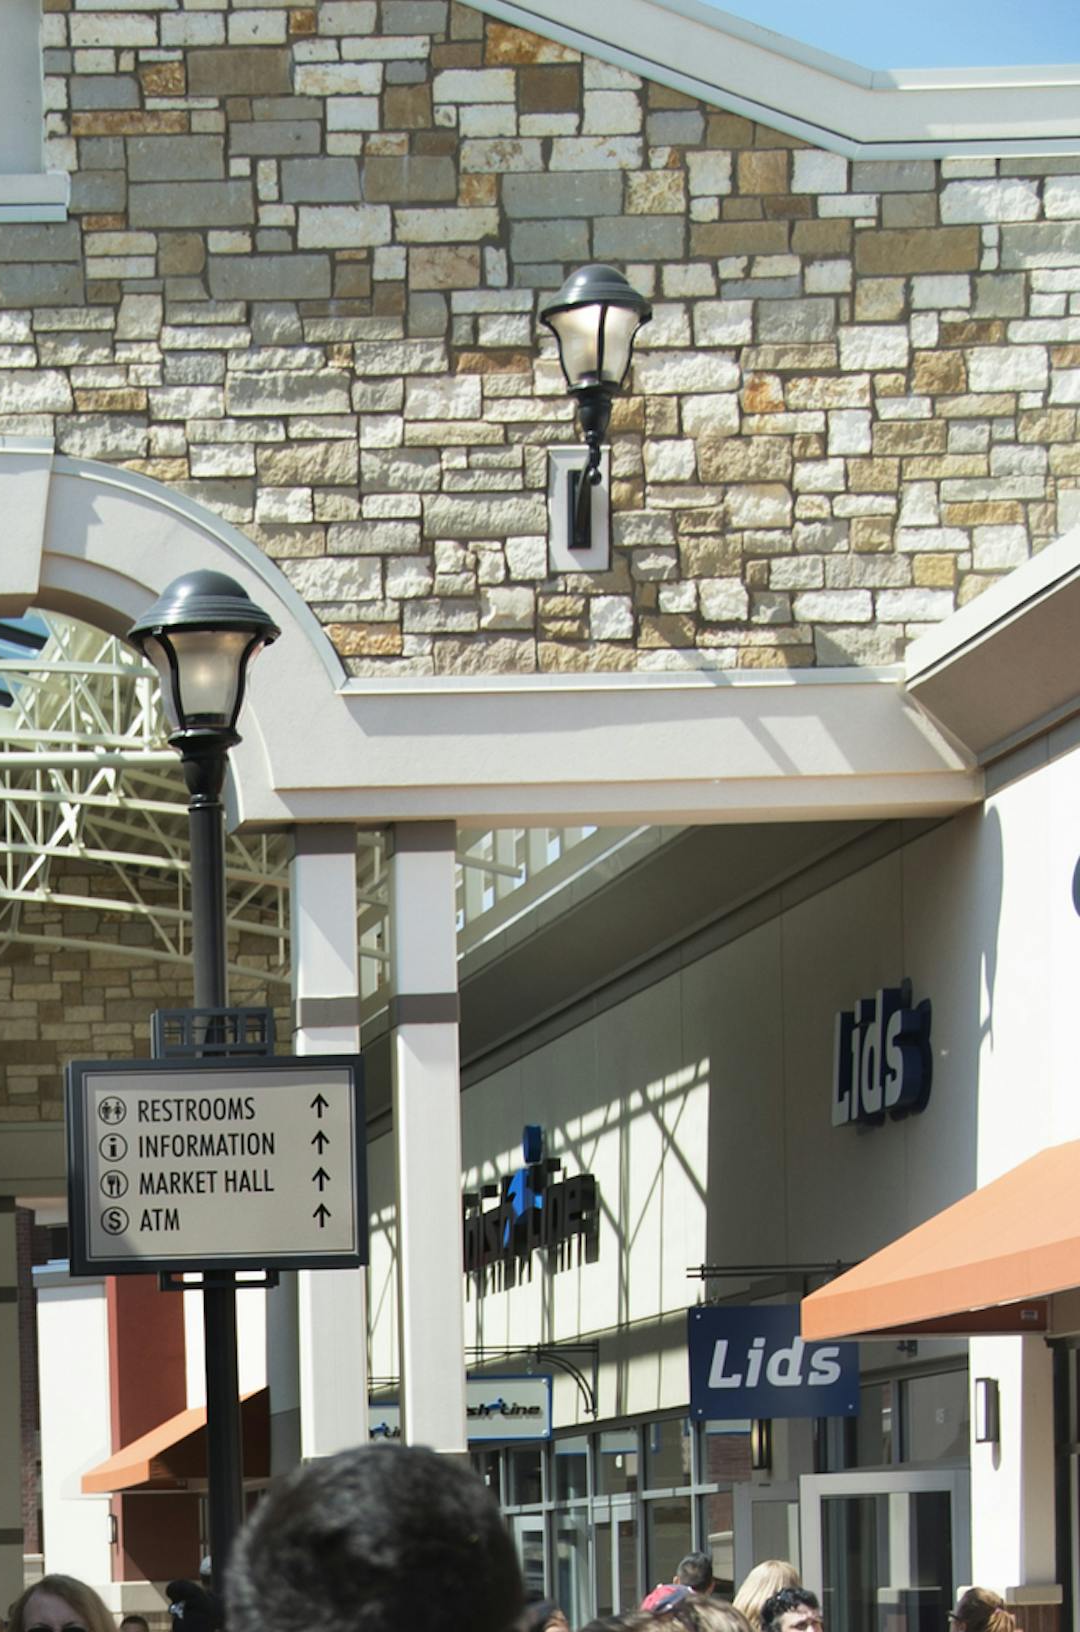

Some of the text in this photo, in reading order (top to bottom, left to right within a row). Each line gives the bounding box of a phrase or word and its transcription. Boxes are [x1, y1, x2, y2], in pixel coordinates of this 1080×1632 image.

[831, 984, 916, 1128] Lids
[138, 1097, 256, 1122] RESTROOMS
[139, 1132, 275, 1158] INFORMATION
[139, 1169, 274, 1195] MARKET HALL
[140, 1208, 180, 1231] ATM
[708, 1335, 841, 1388] Lids
